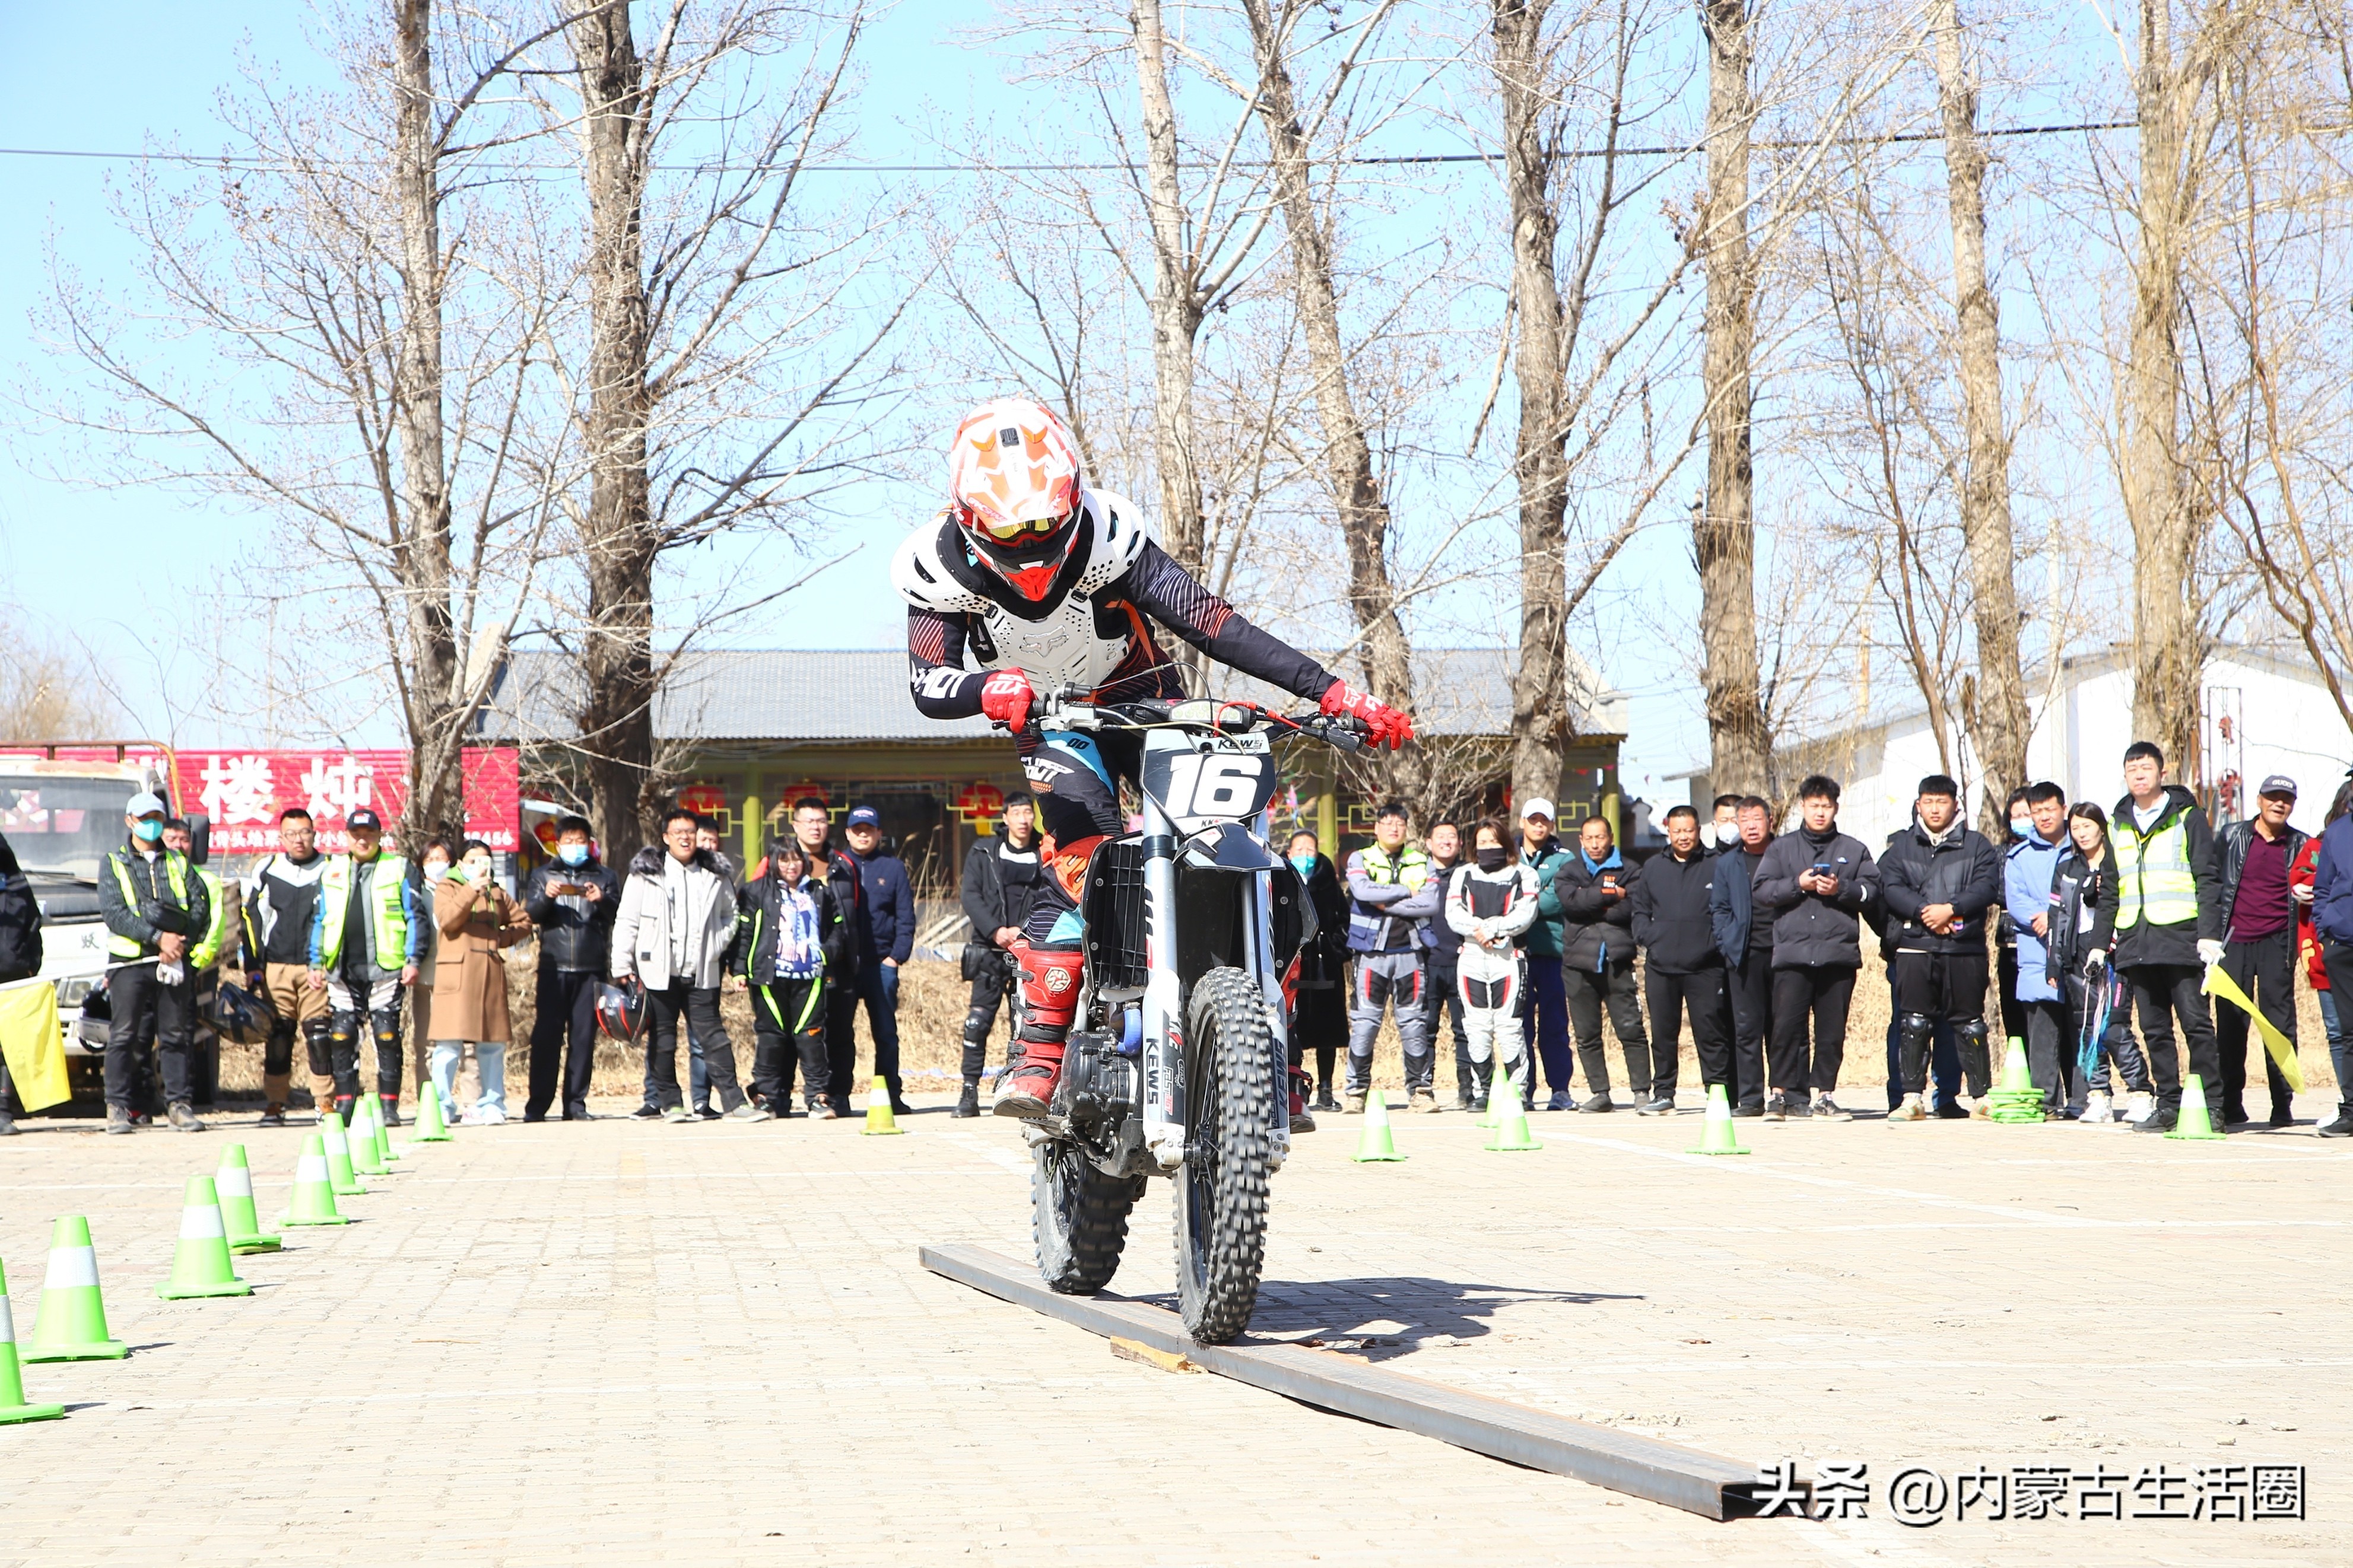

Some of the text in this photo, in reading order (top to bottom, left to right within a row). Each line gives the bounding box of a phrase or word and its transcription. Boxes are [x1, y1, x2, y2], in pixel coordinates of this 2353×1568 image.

[1164, 753, 1263, 819] 16
[1146, 1038, 1160, 1105] KEWS
[1274, 1038, 1288, 1111] KEWS
